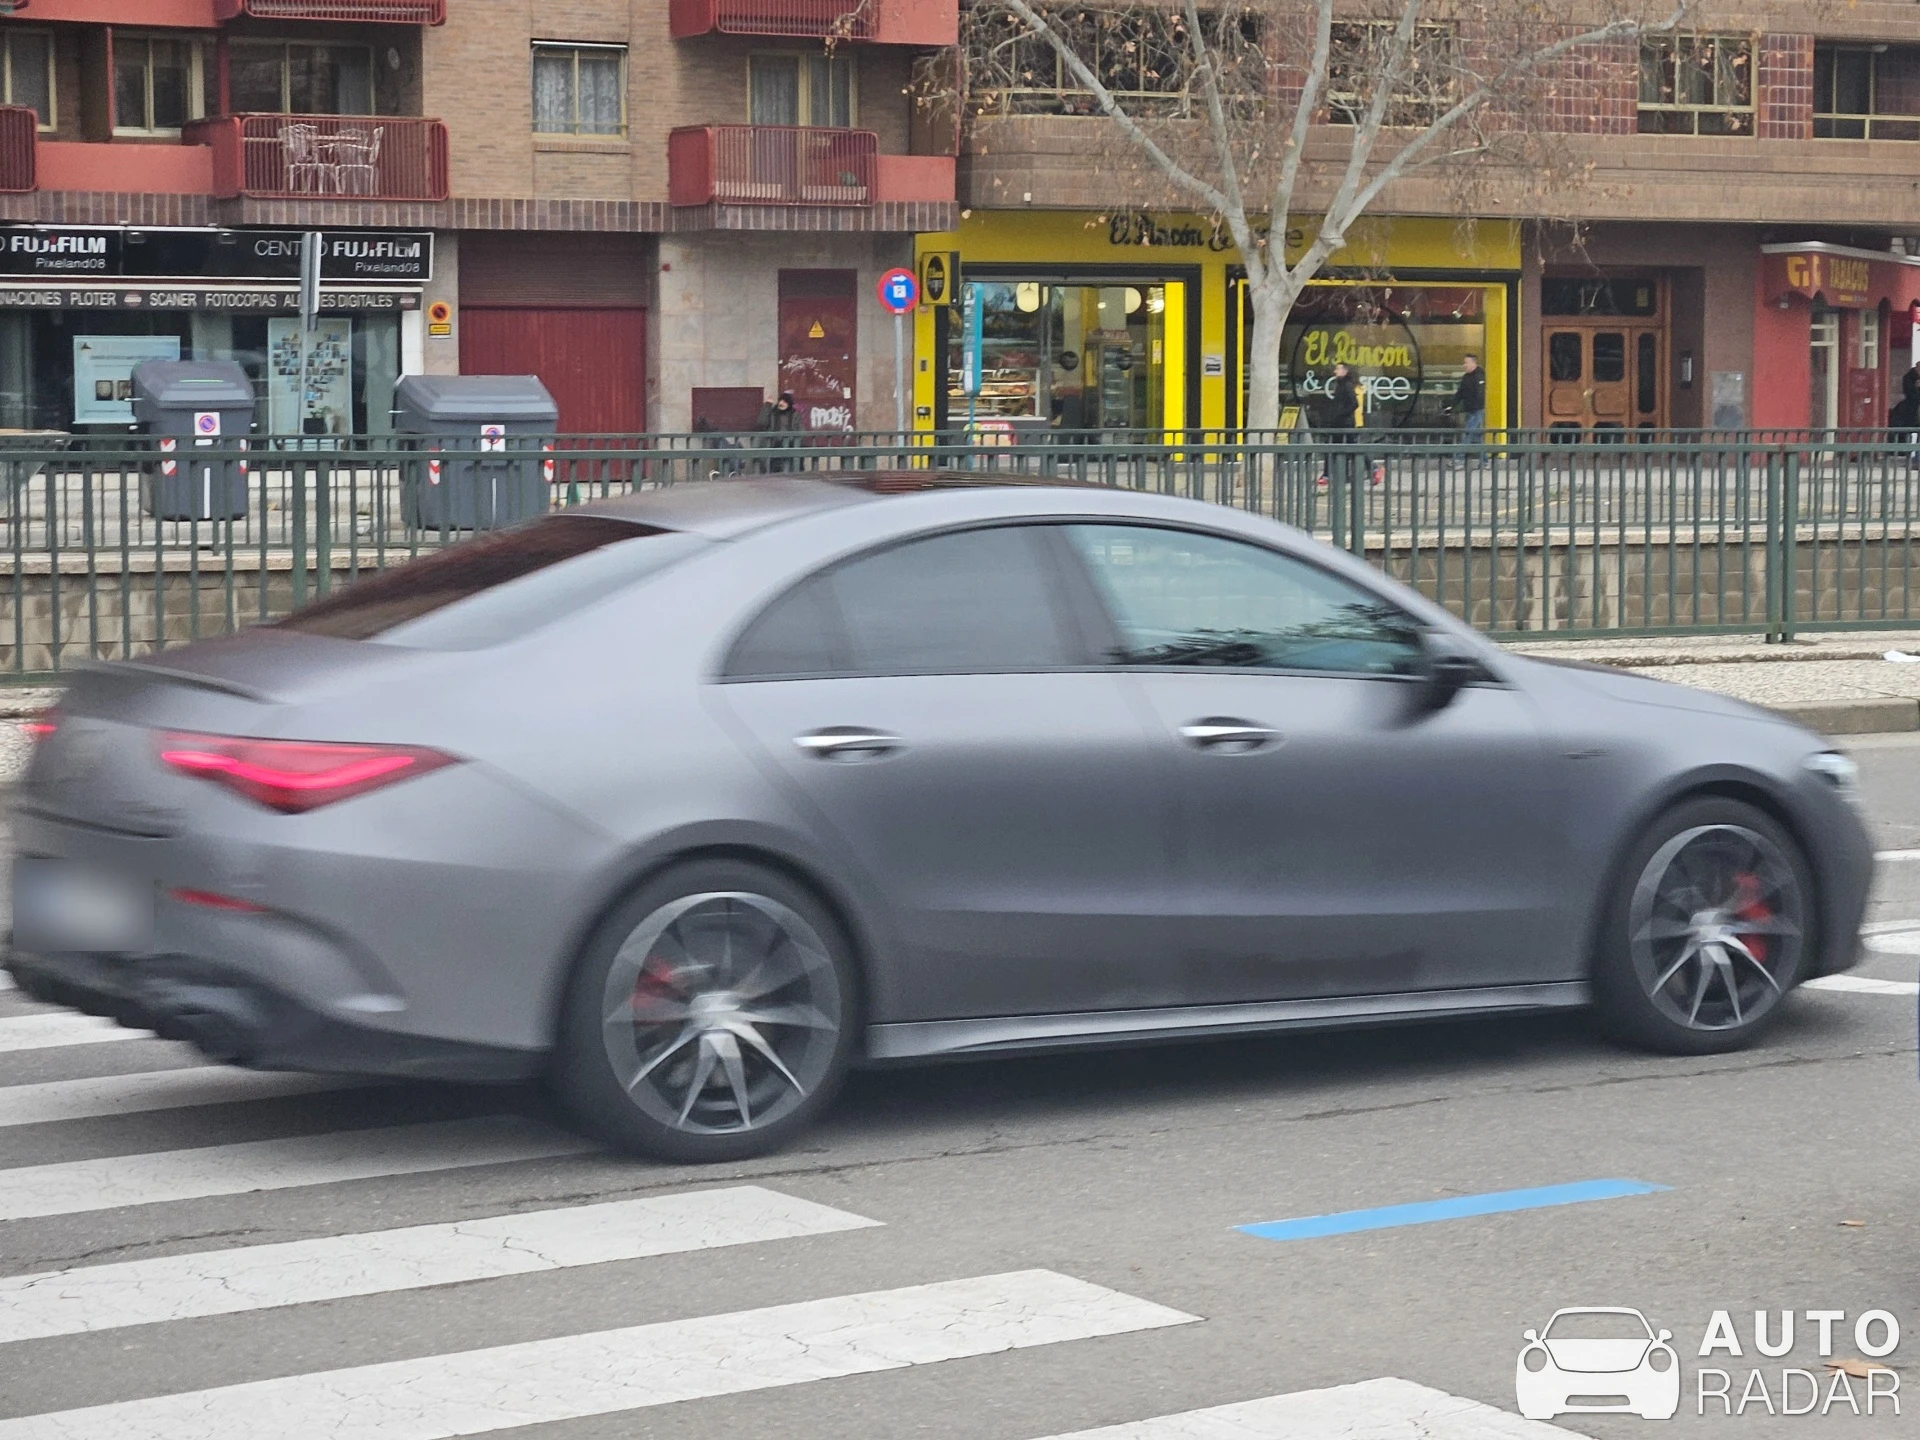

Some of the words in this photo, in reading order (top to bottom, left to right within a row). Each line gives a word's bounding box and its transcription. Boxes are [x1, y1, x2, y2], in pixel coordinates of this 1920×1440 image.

[10, 235, 106, 254] FUJIFILM
[254, 239, 329, 257] CENT
[333, 240, 420, 258] FUJIFILM
[36, 257, 106, 269] Pixeland08
[355, 261, 420, 273] Pixeland08
[70, 292, 117, 306] PLOTER
[205, 293, 277, 308] FOTOCOPIAS
[283, 293, 336, 308] ALES
[337, 294, 393, 308] DIGITALES
[1303, 330, 1330, 366] El
[1331, 330, 1412, 367] Rincón
[1302, 369, 1323, 392] &
